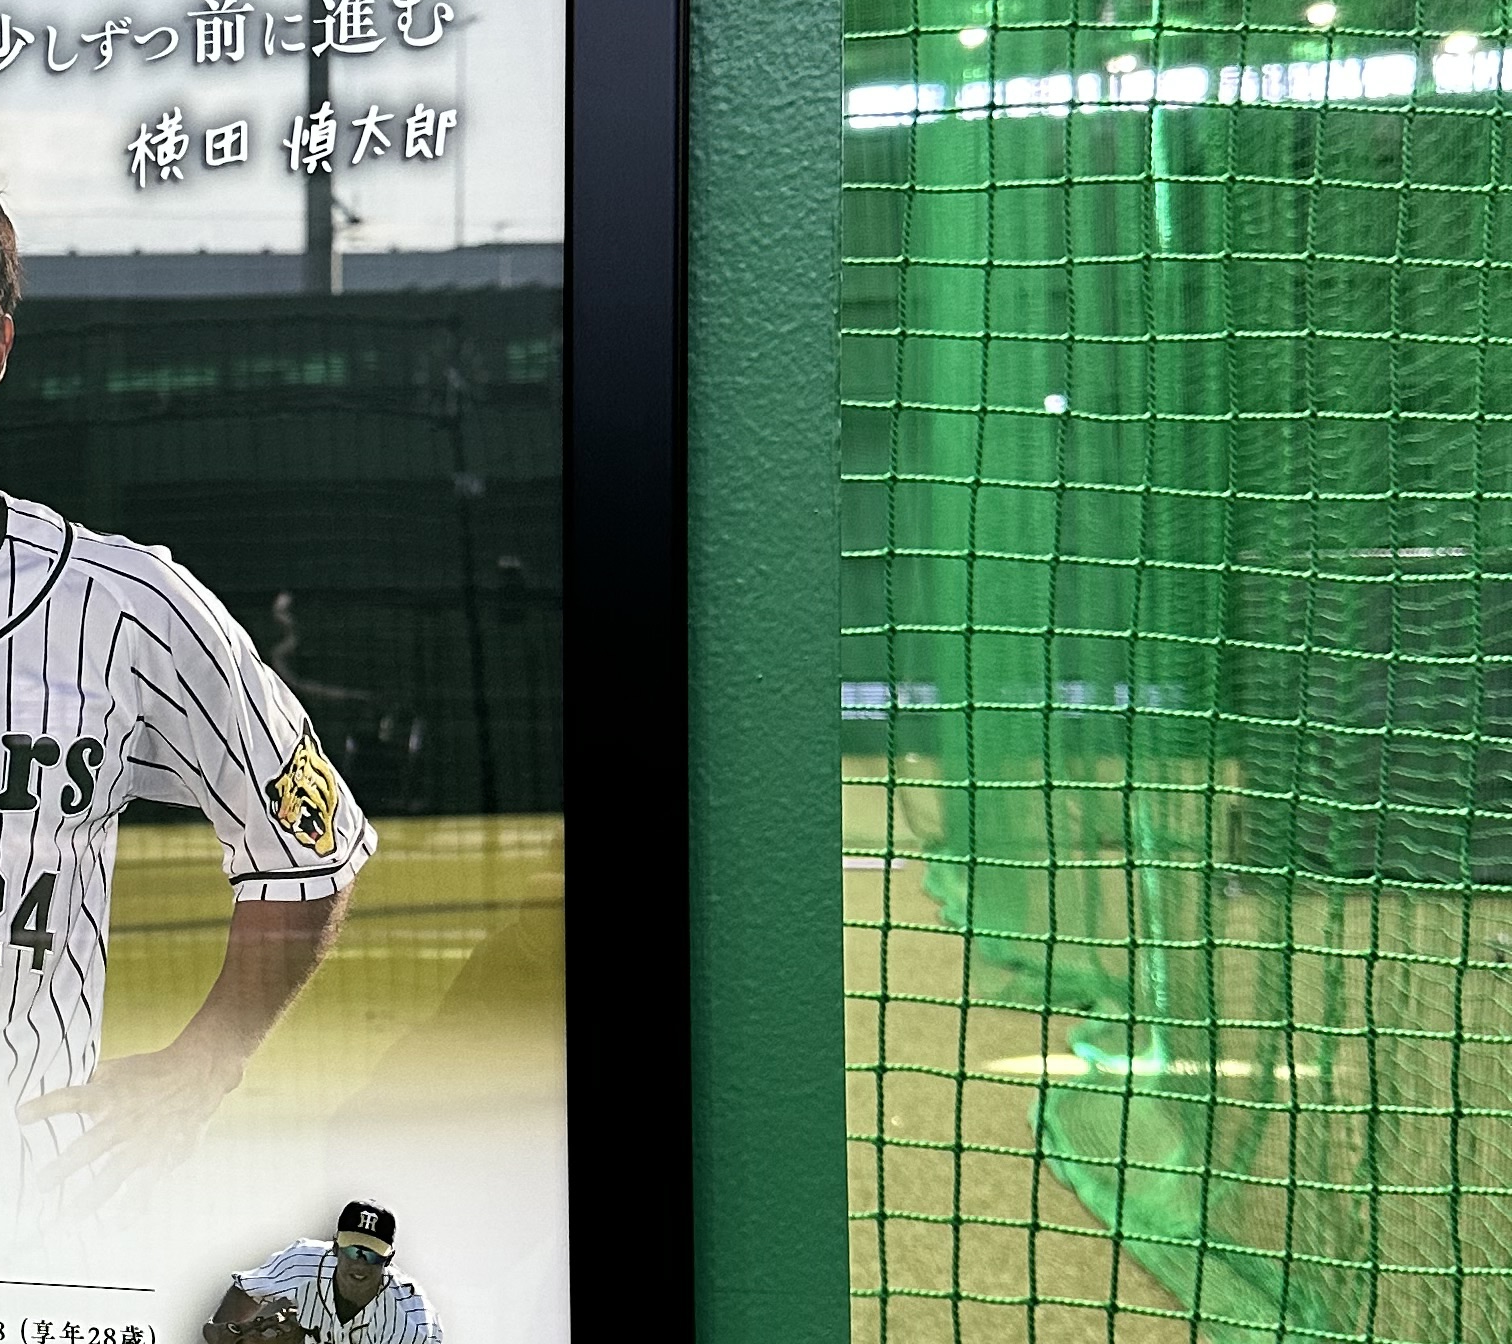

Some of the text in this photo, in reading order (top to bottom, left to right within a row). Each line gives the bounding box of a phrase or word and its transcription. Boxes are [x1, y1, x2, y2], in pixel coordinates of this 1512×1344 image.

[127, 101, 457, 188] 横田 慎太郎
